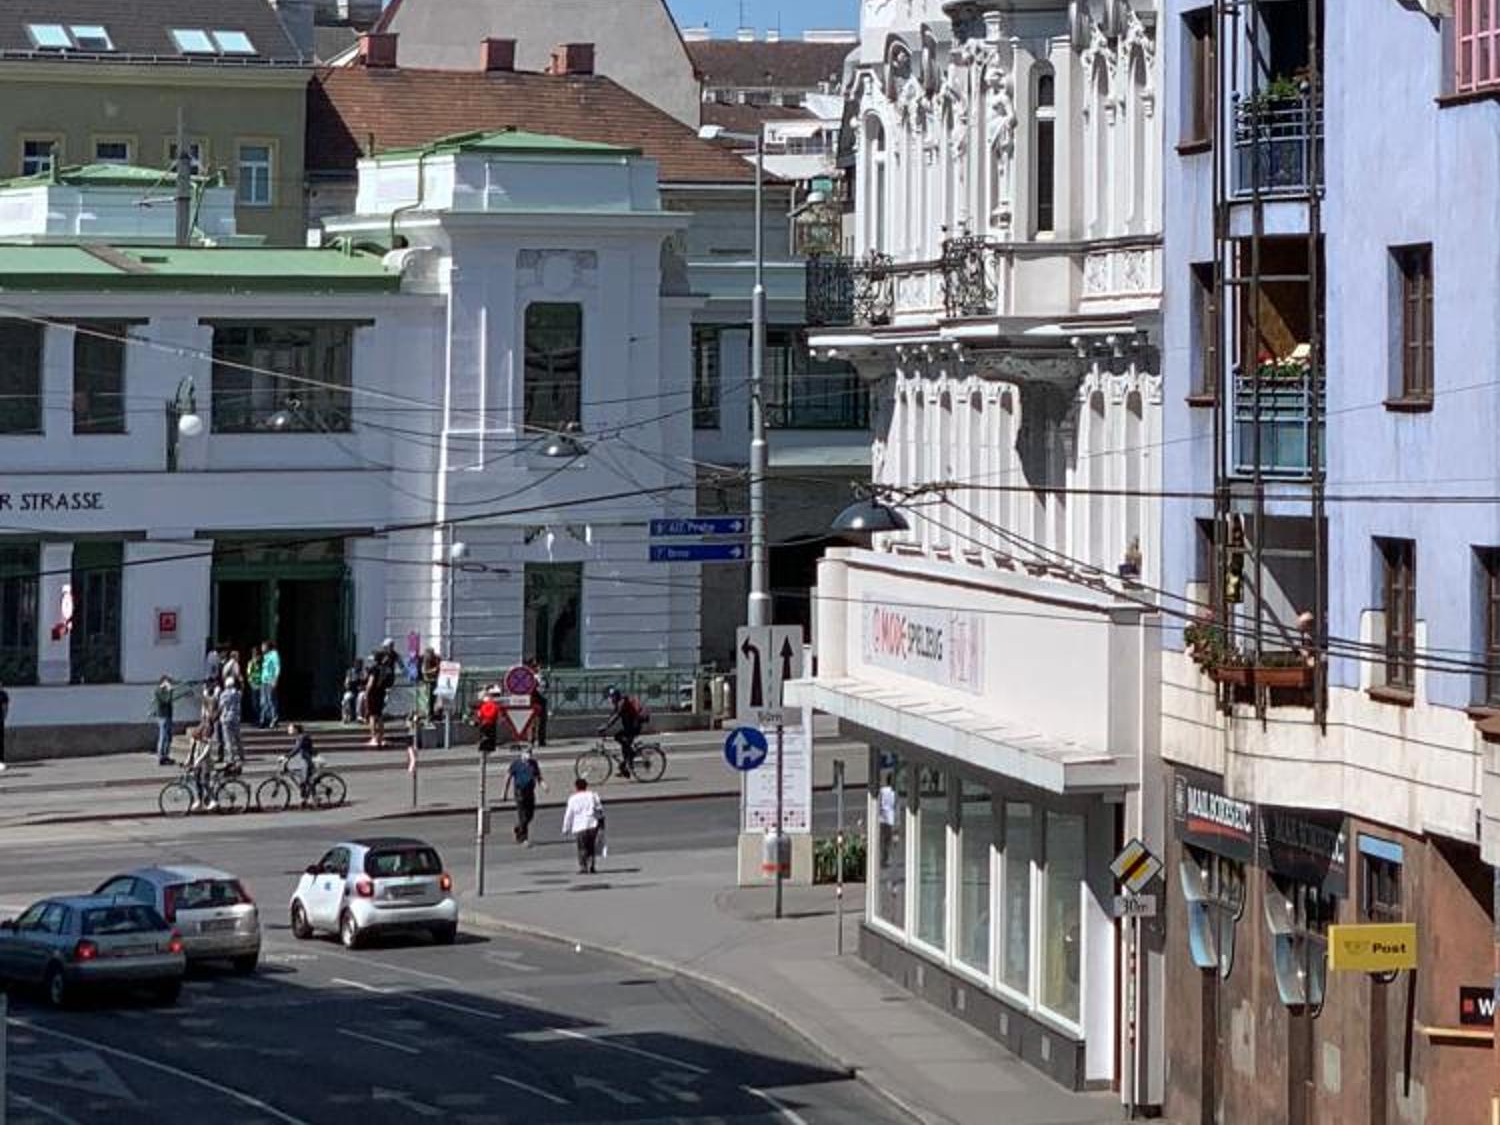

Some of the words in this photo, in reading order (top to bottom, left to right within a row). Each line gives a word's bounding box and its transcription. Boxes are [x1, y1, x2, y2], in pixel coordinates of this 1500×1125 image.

[20, 492, 104, 510] STRASSE
[1187, 786, 1209, 818] MAIL
[1372, 942, 1407, 954] Post
